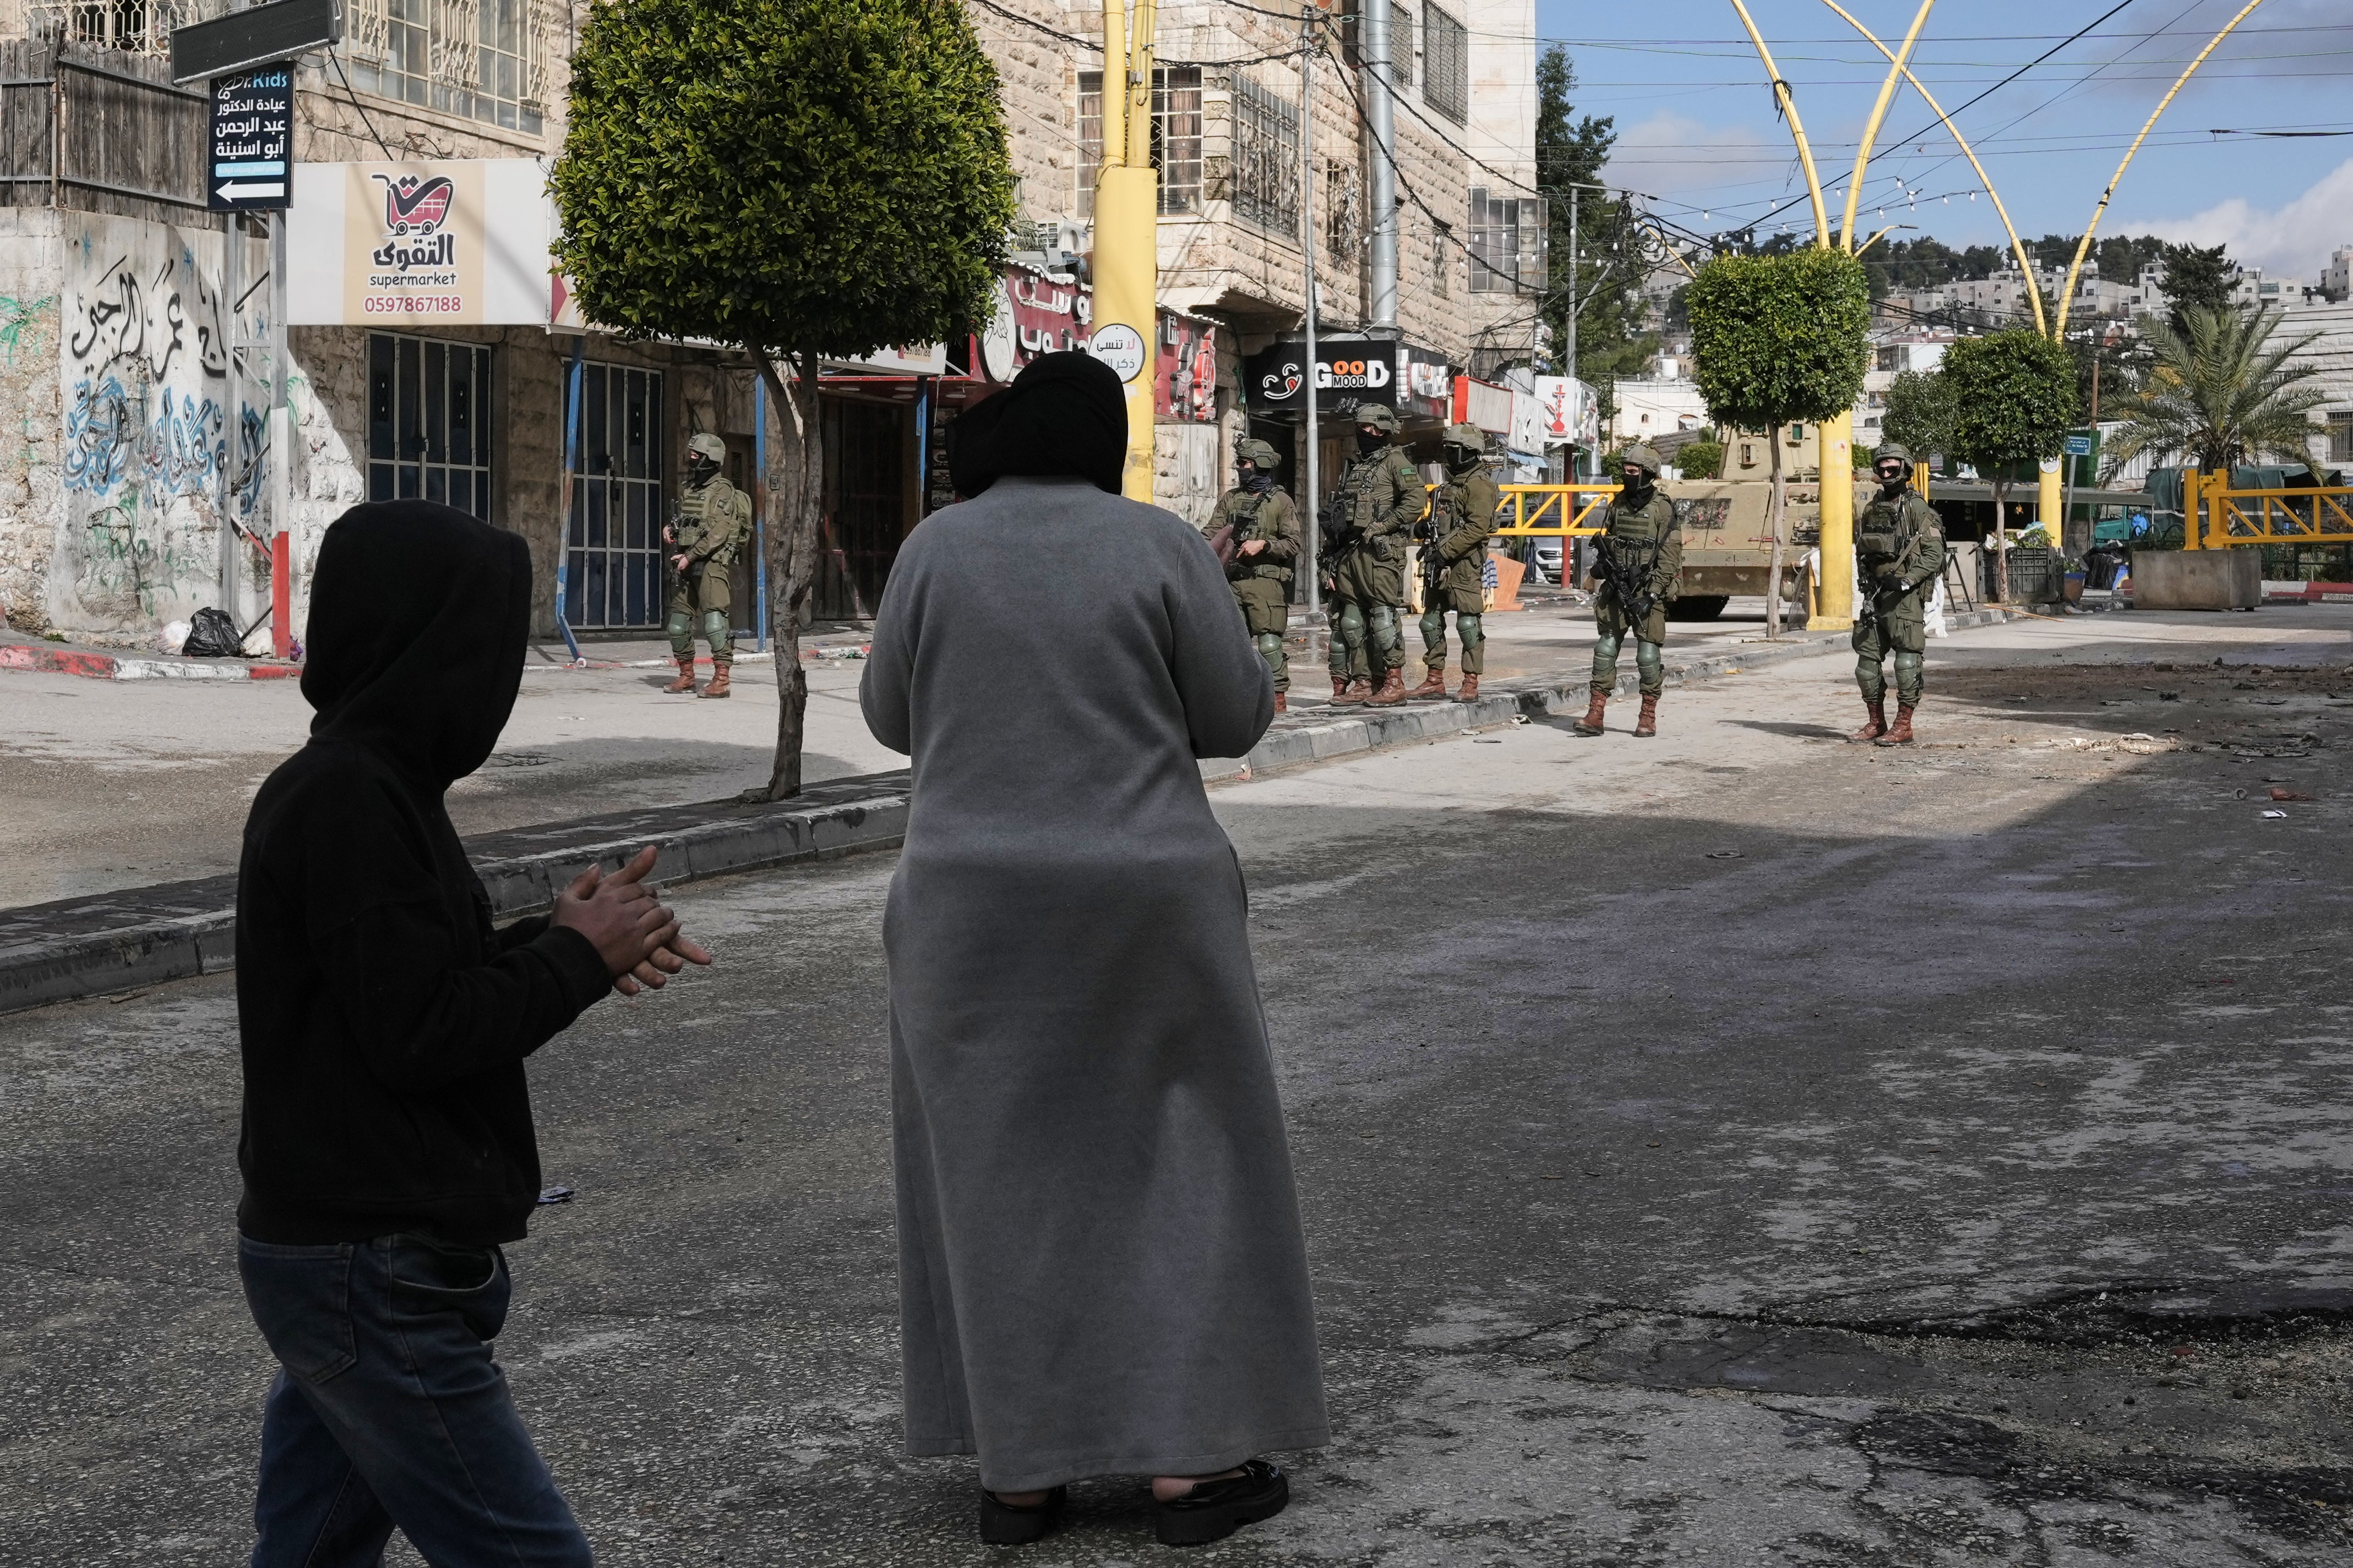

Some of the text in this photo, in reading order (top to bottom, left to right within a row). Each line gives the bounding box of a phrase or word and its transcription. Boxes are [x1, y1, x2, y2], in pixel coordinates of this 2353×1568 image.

[217, 98, 286, 116] عيادة الدكتور
[216, 117, 286, 138] عبد الرحمن
[216, 134, 285, 160] أبو اسنينة
[373, 233, 454, 272] التقوى
[370, 271, 456, 289] supermarket
[365, 297, 461, 313] 0597867188
[1097, 337, 1135, 352] لا تنسى
[1115, 358, 1135, 370] ذكر
[1333, 375, 1366, 388] MOOD
